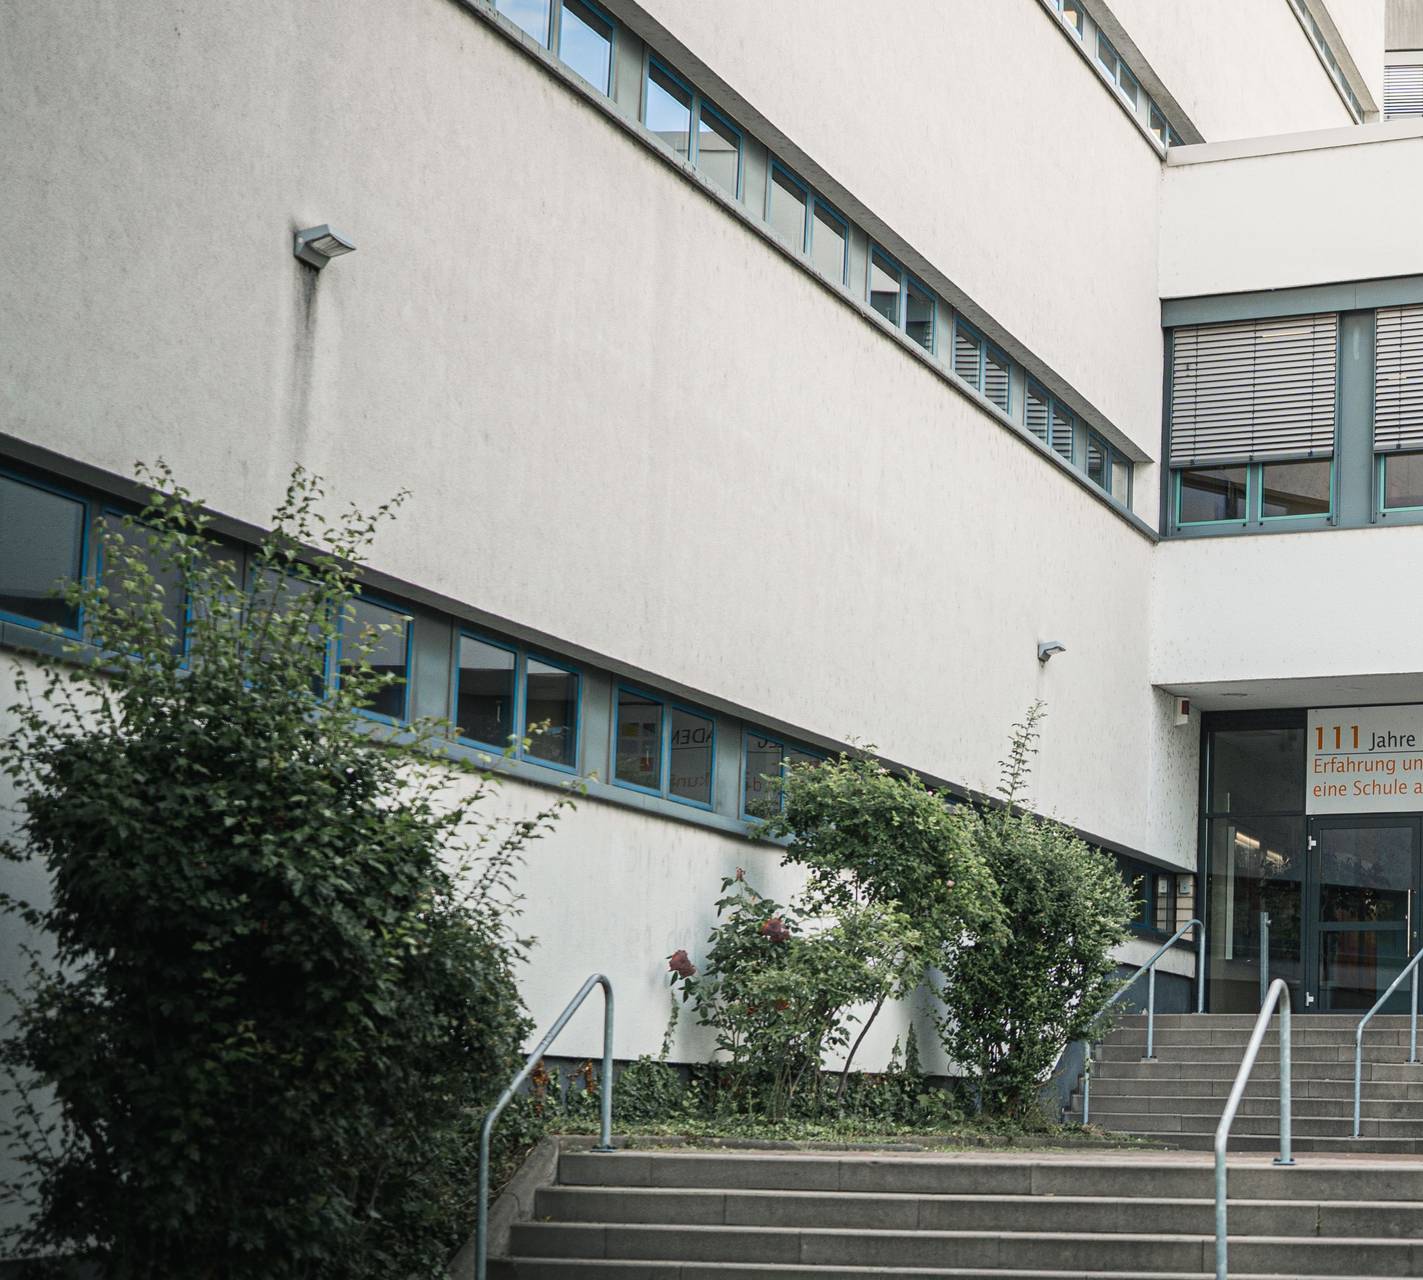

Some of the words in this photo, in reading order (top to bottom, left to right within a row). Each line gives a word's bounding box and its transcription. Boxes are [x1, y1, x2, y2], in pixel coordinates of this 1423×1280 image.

[1315, 724, 1360, 750] 111
[1368, 730, 1416, 751] Jahre
[1313, 756, 1396, 775] Erfahrung
[1313, 781, 1348, 797] eine
[1352, 778, 1408, 797] Schule
